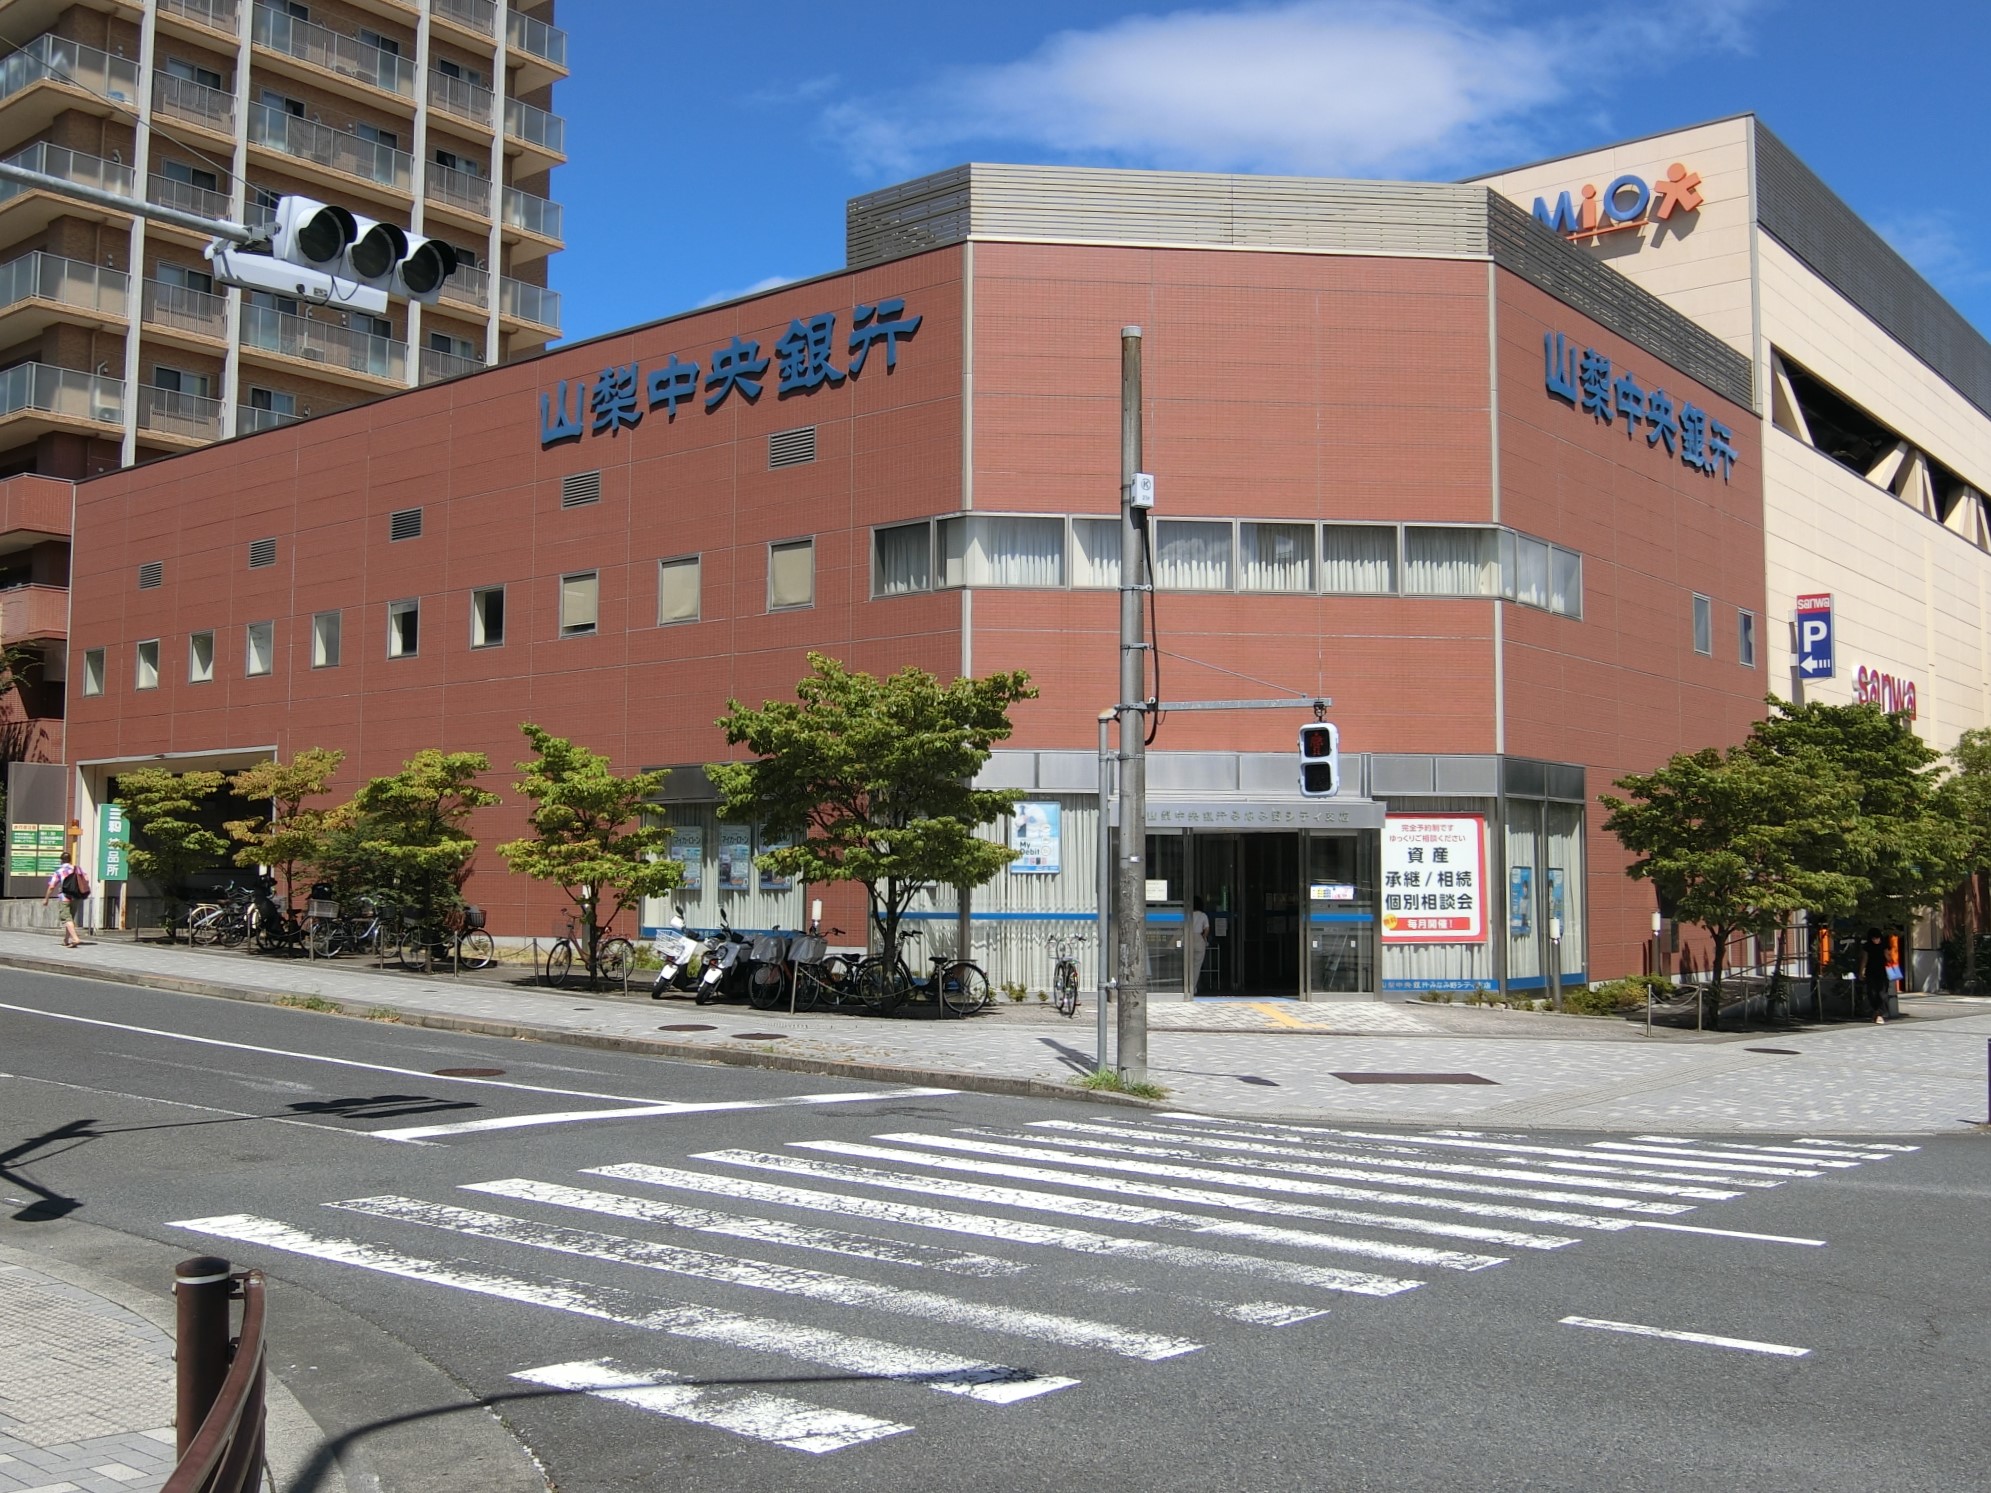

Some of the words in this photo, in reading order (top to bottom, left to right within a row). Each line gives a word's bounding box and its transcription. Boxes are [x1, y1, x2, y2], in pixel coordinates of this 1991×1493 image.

[541, 299, 923, 444] 山梨中央銀行
[1544, 332, 1739, 481] 山梨中央銀行
[1797, 597, 1830, 610] sanwa
[1803, 620, 1828, 653] P
[1855, 665, 1917, 721] sanwa
[1385, 893, 1473, 911] 個別相談会
